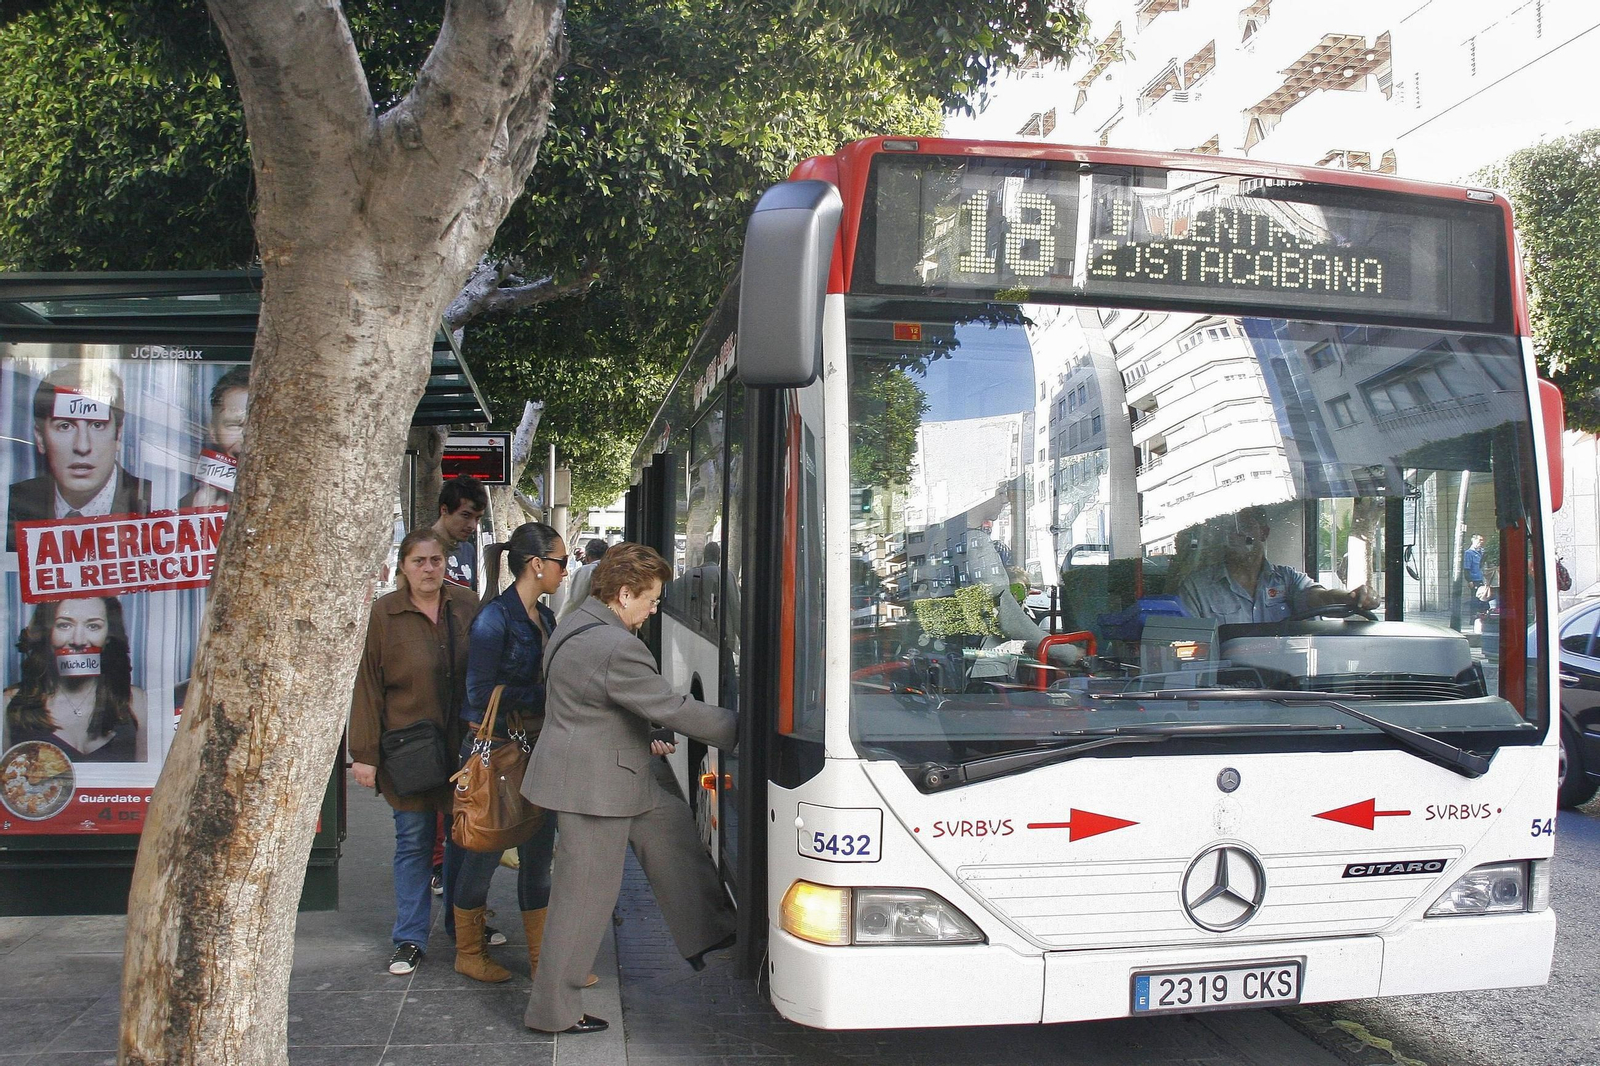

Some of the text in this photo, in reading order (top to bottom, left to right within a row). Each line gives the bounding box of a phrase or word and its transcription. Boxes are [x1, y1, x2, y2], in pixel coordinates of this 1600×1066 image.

[959, 190, 1056, 277] 18
[131, 346, 203, 361] JCDecaux
[69, 398, 98, 415] Jim
[215, 453, 237, 464] HELLO
[35, 515, 226, 566] AMERICAN
[36, 566, 72, 591] EL
[60, 658, 99, 670] Michelle
[79, 794, 141, 803] Guárdate
[98, 807, 140, 821] 4 DE
[813, 831, 871, 856] 5432
[1348, 861, 1442, 876] CITARO
[1158, 969, 1292, 1006] 2319 CKS
[1139, 996, 1146, 1005] E
